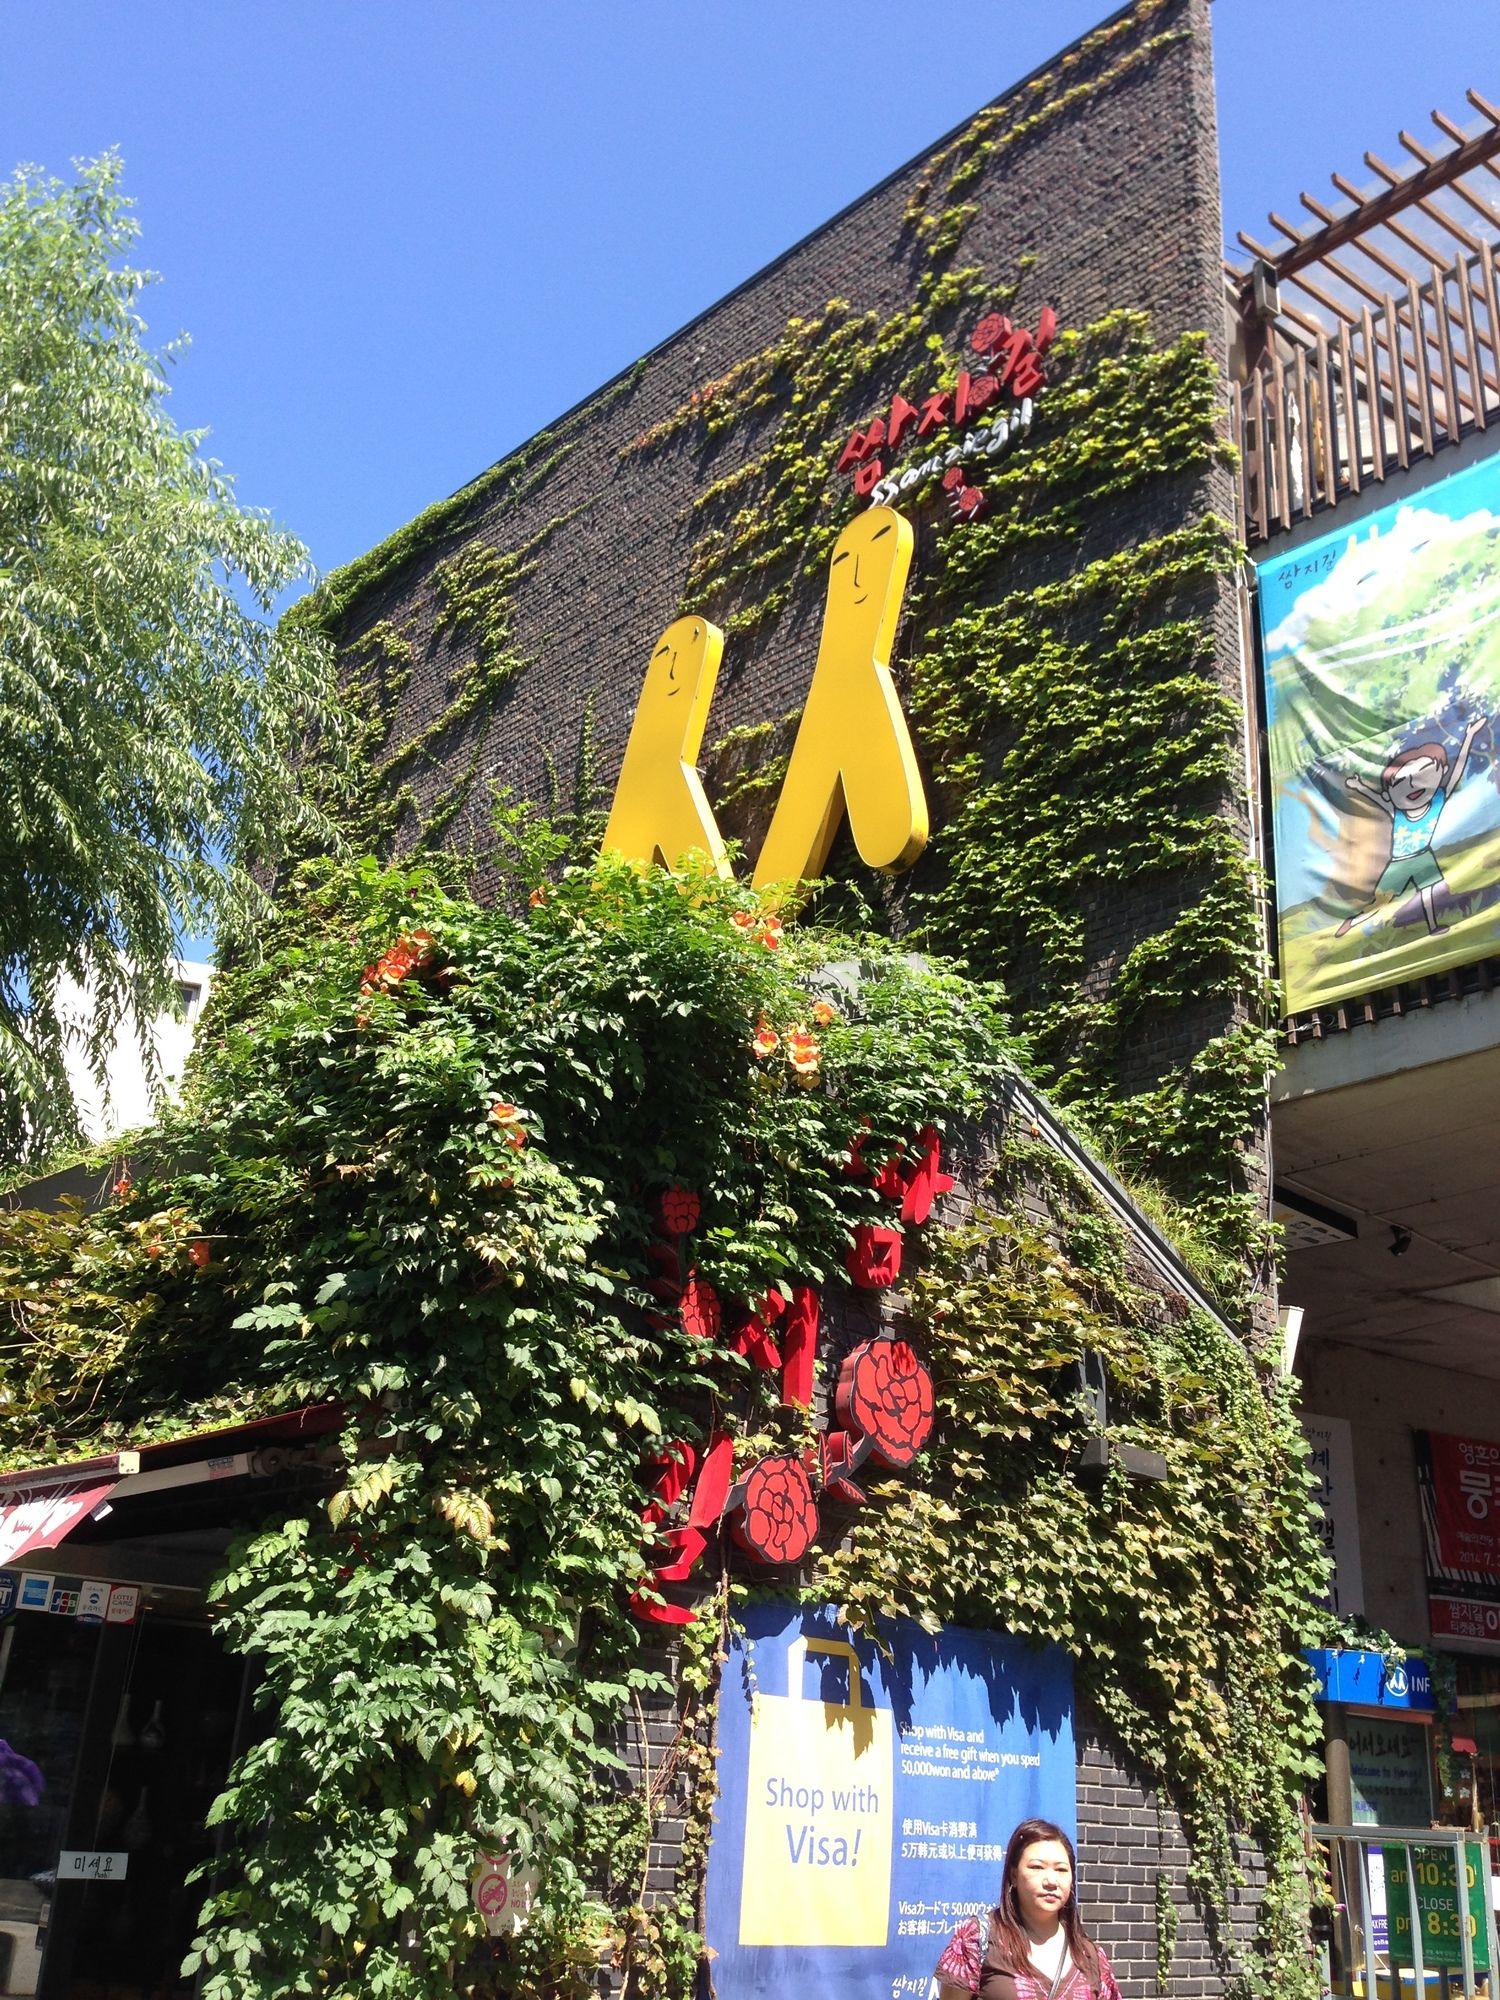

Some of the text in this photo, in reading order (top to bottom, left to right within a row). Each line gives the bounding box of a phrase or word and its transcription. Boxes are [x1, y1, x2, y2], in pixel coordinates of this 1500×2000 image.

[837, 304, 1057, 497] 쌈지길
[1278, 551, 1336, 589] 쌈지길
[900, 1721, 985, 1744] Shop with Visa and
[900, 1743, 934, 1757] receive
[935, 1746, 941, 1758] a
[942, 1744, 960, 1760] free
[961, 1746, 978, 1764] gift
[978, 1748, 1000, 1764] when
[1000, 1752, 1019, 1767] you
[951, 1765, 971, 1780] and
[766, 1777, 879, 1817] Shop with
[785, 1824, 862, 1867] Visa!
[892, 1975, 928, 1999] 쌈지길
